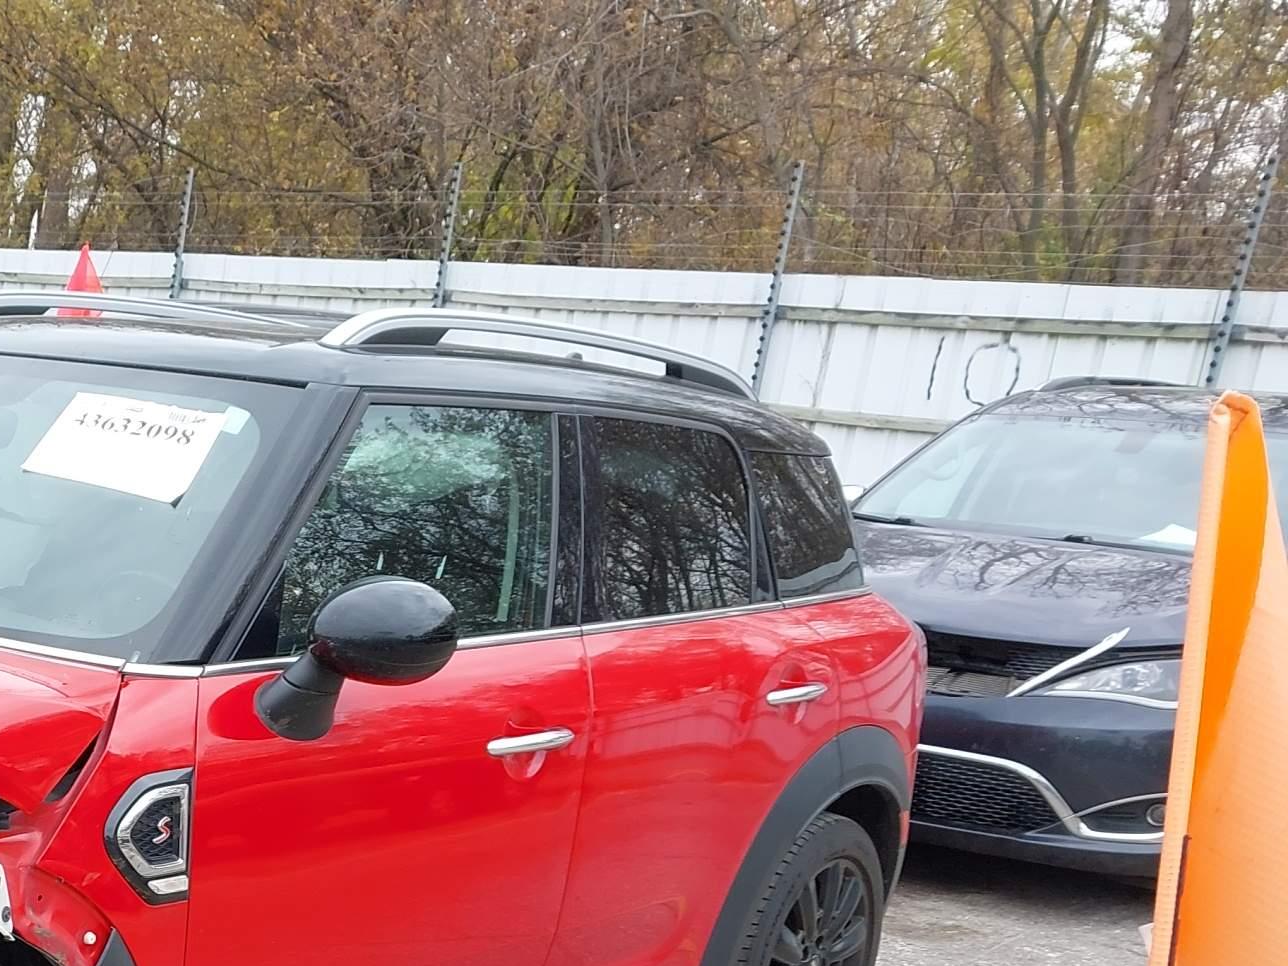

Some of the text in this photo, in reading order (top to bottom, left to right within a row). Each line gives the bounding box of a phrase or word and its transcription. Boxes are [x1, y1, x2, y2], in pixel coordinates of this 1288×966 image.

[924, 335, 1021, 407] 10
[73, 411, 195, 446] 43632098
[152, 815, 172, 845] S
